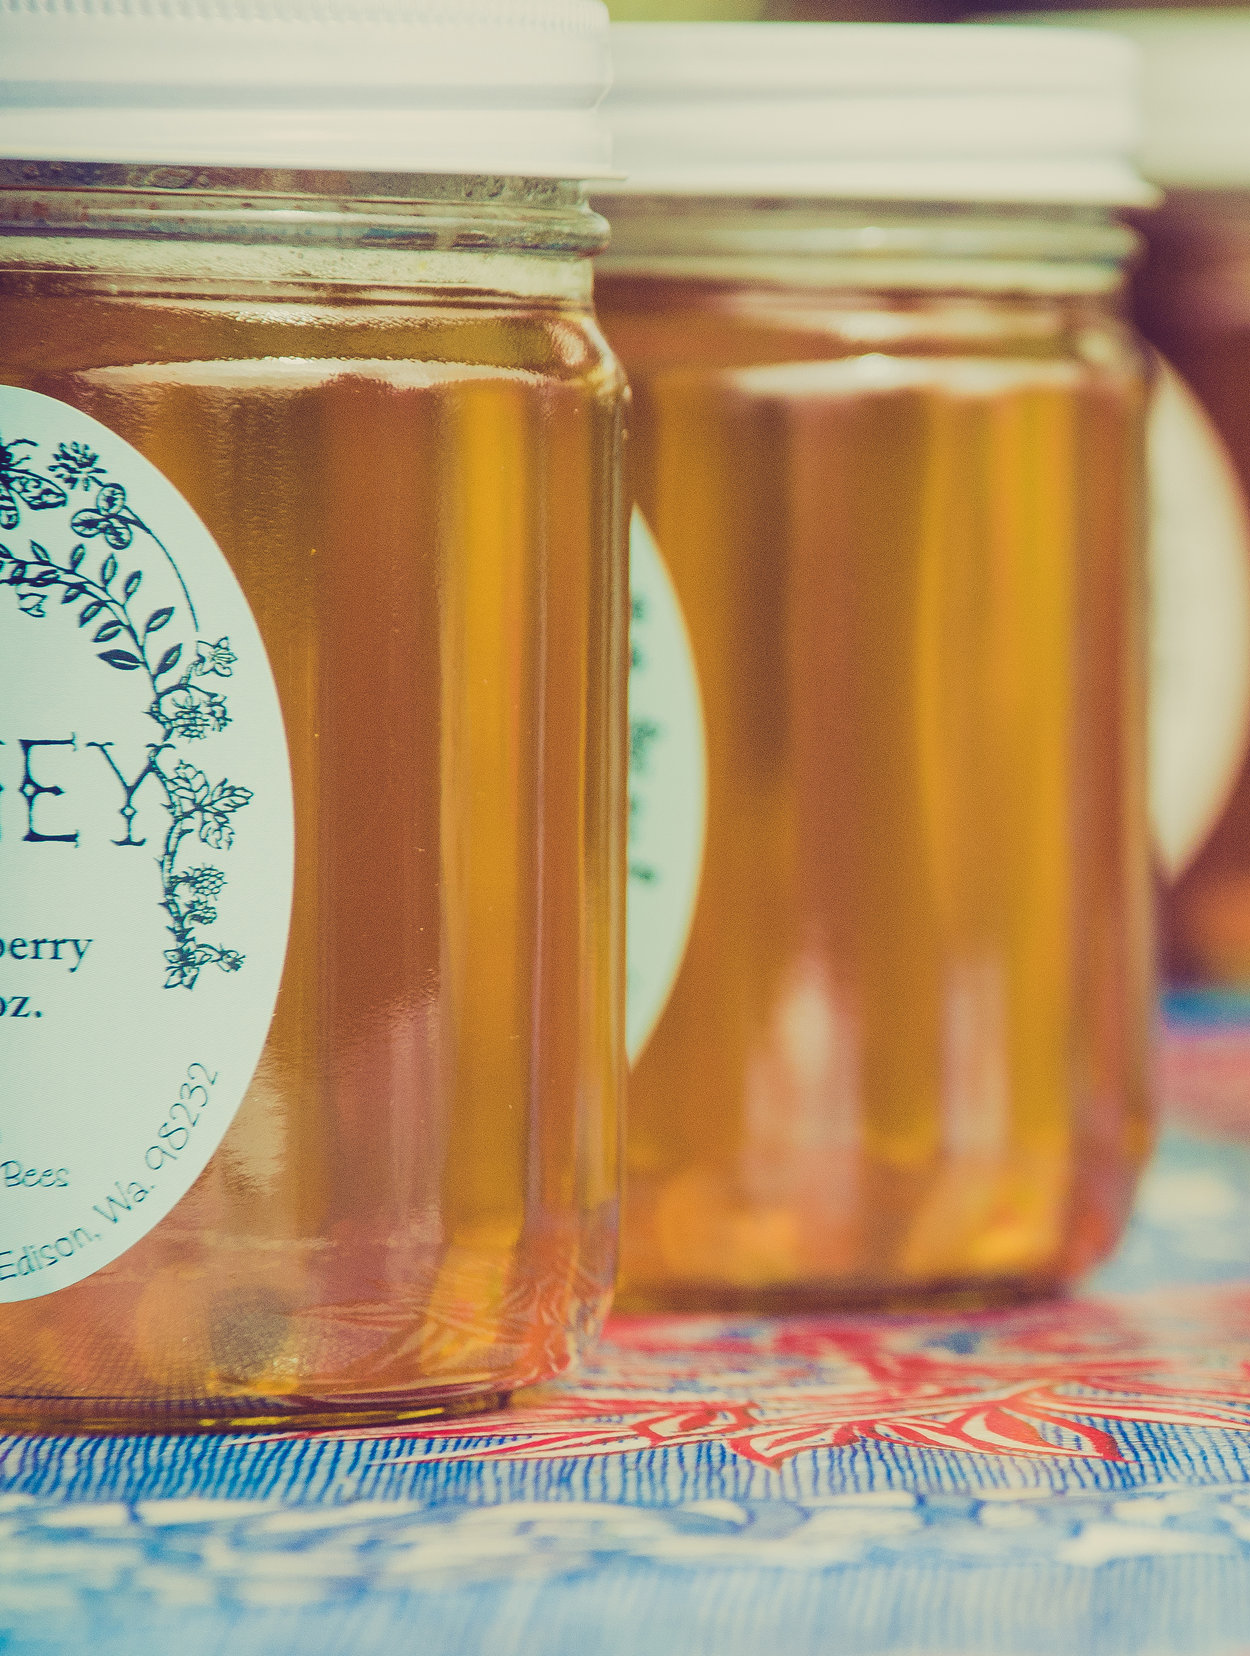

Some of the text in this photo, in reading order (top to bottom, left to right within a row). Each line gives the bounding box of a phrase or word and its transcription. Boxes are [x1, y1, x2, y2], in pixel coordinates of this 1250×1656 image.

[0, 732, 176, 848] EY
[0, 1160, 70, 1187] Bees
[92, 1181, 156, 1224] Wa.
[145, 1062, 219, 1171] 98232
